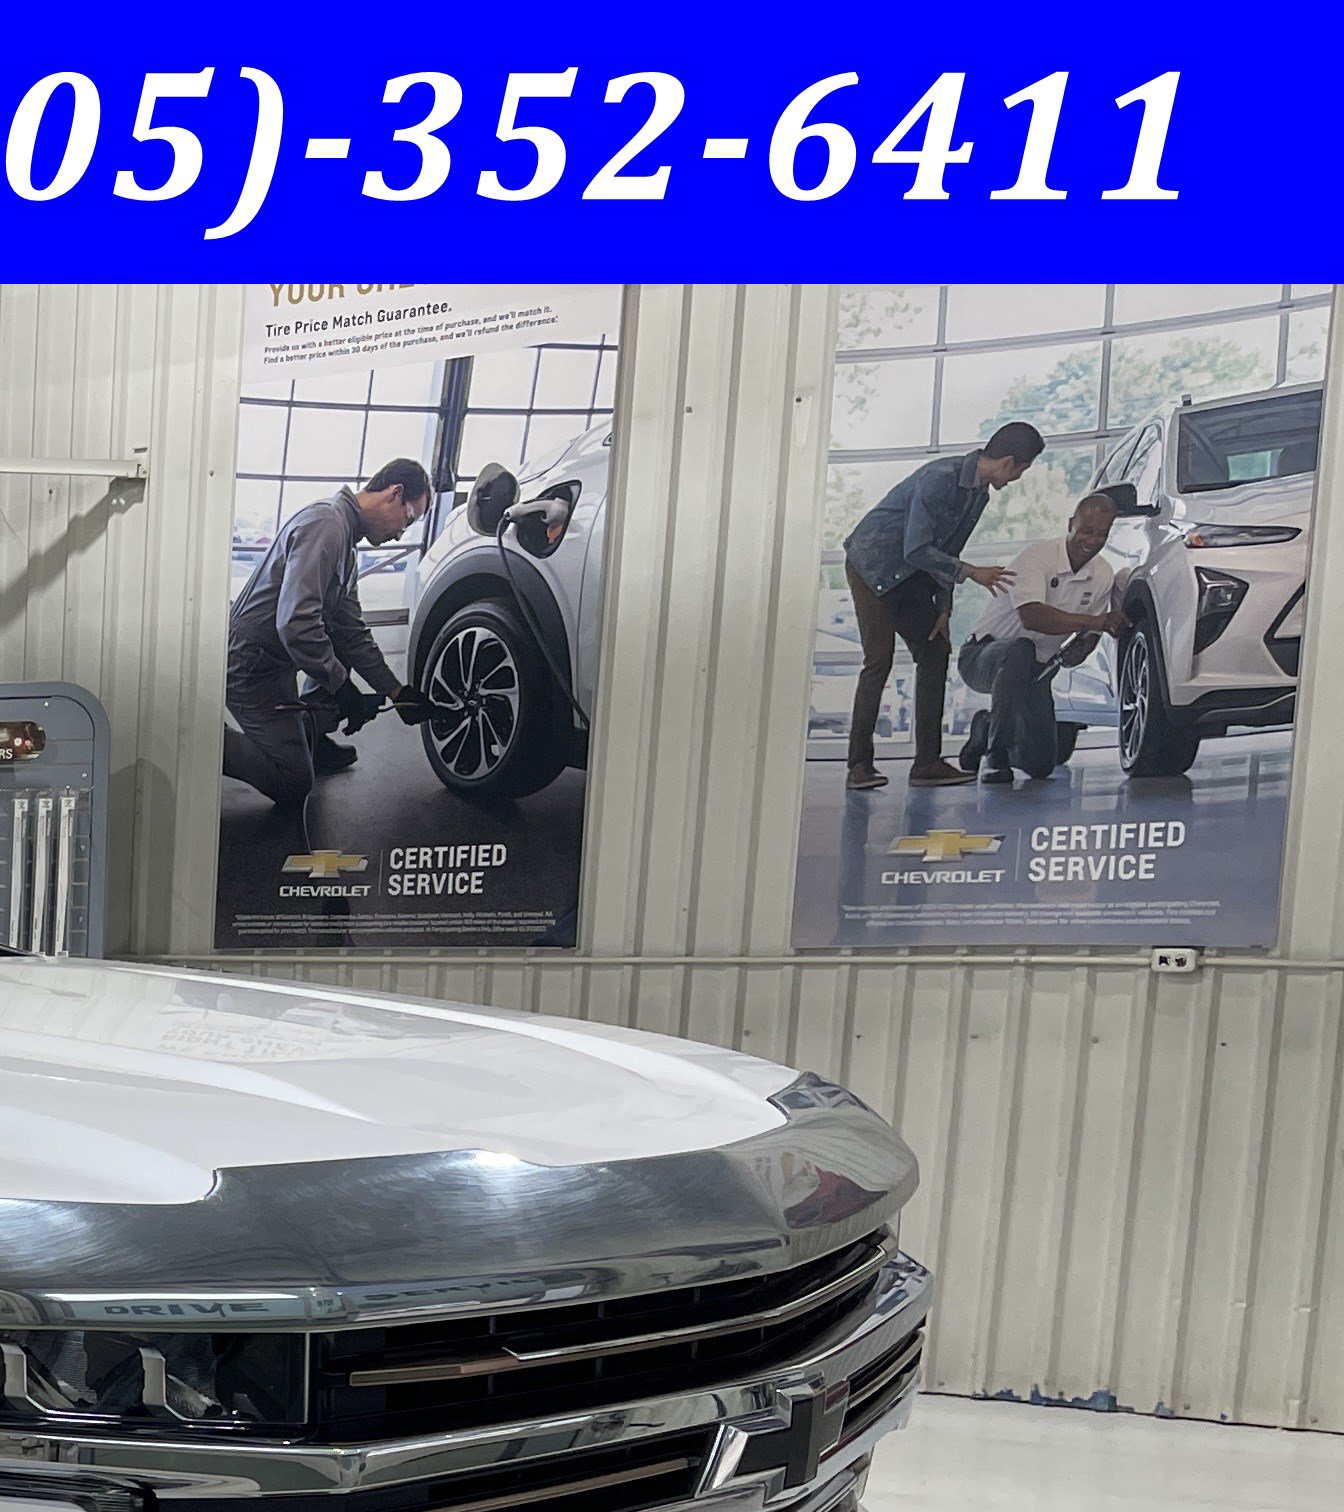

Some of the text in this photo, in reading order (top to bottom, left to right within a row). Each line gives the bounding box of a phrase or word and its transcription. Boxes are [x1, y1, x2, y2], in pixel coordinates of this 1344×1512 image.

[266, 302, 453, 338] Tire Price Match Guarantee.
[323, 338, 346, 347] better
[374, 331, 393, 341] price
[483, 314, 497, 324] and
[517, 307, 542, 318] match
[285, 353, 308, 362] better
[308, 350, 327, 361] price
[362, 344, 378, 353] days
[440, 332, 454, 341] and
[473, 325, 499, 336] refund
[1030, 821, 1186, 851] CERTIFIED
[389, 844, 507, 870] CERTIFIED
[1027, 853, 1157, 883] SERVICE
[279, 885, 371, 897] CHEVROLET
[387, 871, 484, 896] SERVICE
[881, 869, 1005, 885] CHEVROLET
